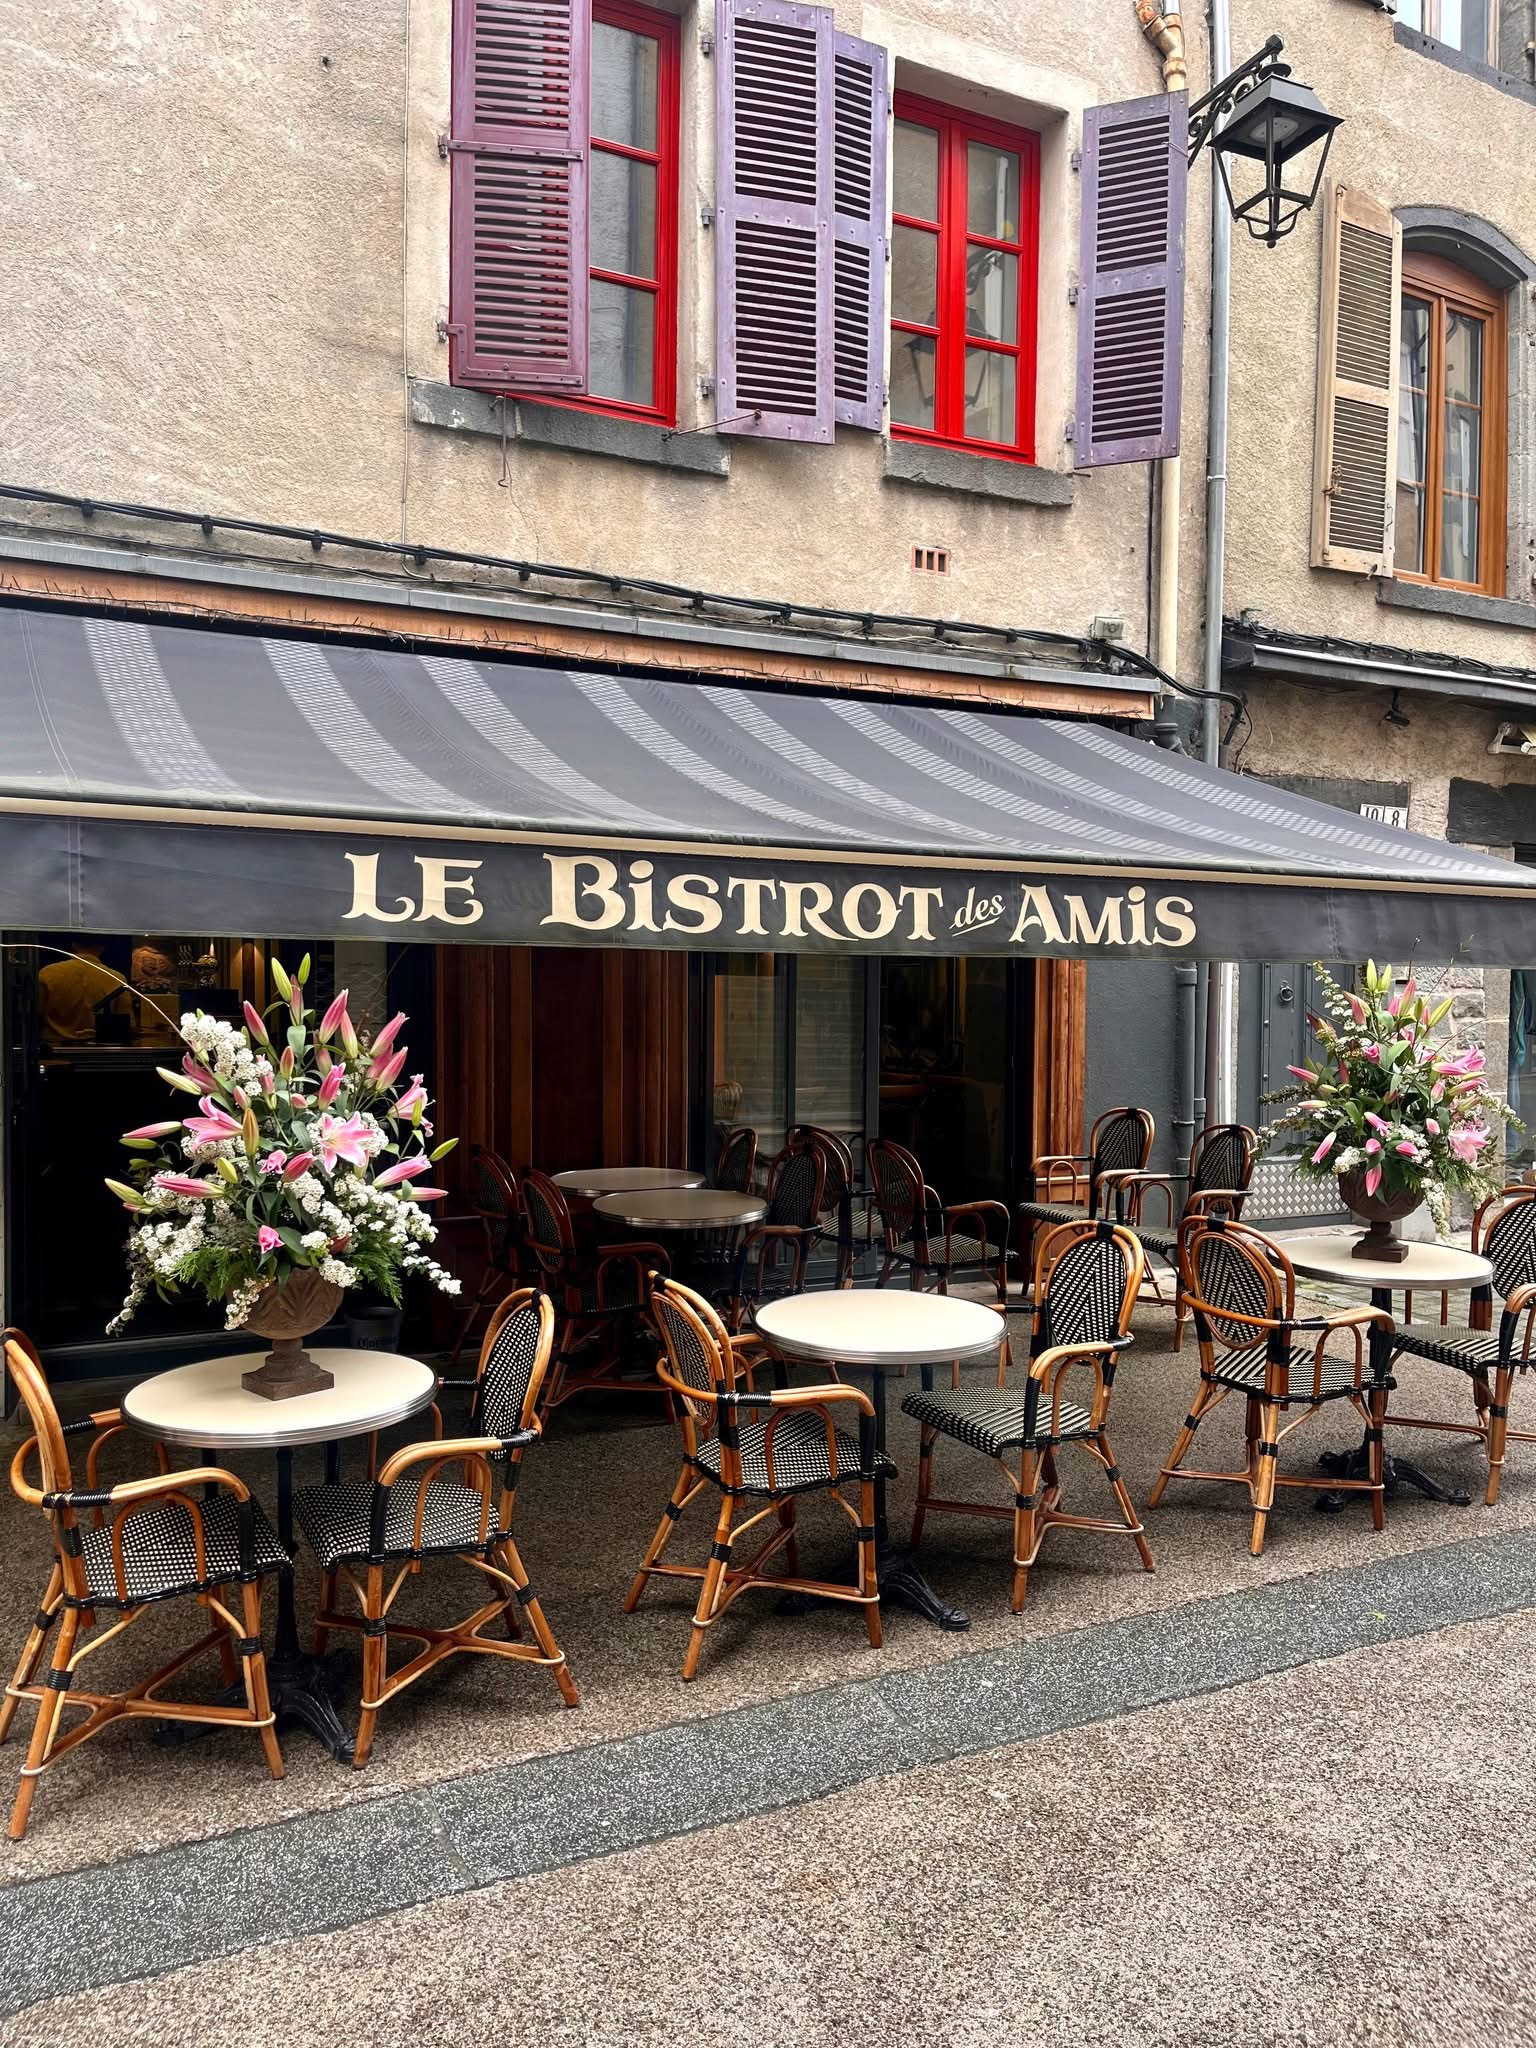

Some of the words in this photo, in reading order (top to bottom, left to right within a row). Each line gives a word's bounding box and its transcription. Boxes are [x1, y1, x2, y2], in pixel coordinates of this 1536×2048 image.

[1365, 807, 1379, 821] 10
[1391, 810, 1400, 828] 8
[340, 852, 484, 925] LE
[948, 886, 1006, 930] des
